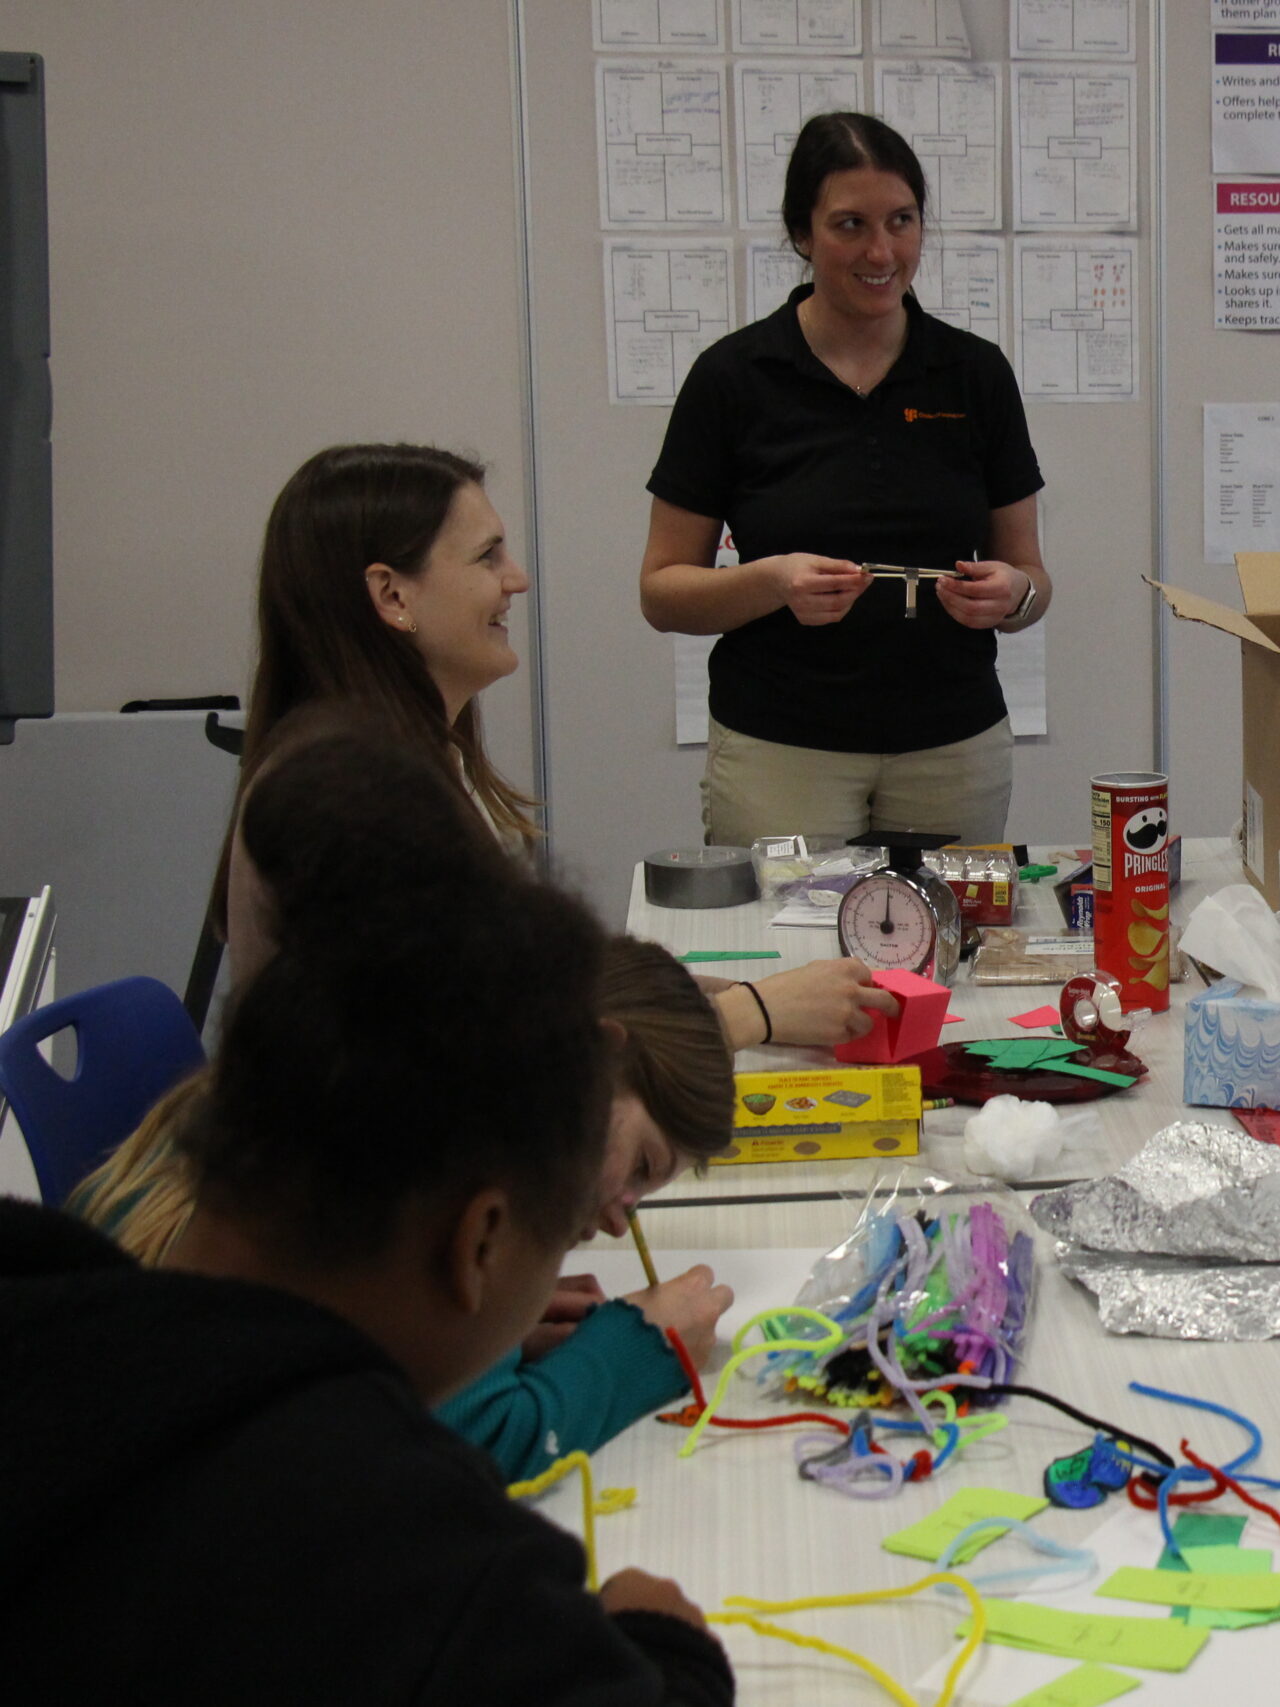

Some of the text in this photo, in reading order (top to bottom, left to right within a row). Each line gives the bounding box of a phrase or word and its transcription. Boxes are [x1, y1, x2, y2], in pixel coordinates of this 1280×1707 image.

[1222, 75, 1256, 86] Writes
[1258, 76, 1280, 86] and
[1222, 96, 1255, 107] Offers
[1223, 109, 1275, 123] complete
[1224, 224, 1249, 235] Gets
[1250, 224, 1264, 235] all
[1224, 240, 1259, 250] Makes
[1224, 252, 1280, 266] and safely.
[1225, 268, 1259, 279] Makes
[1225, 285, 1256, 295] Looks
[1225, 297, 1272, 308] shares it.
[1225, 314, 1257, 327] Keeps
[1116, 795, 1149, 803] BURSTING
[1100, 819, 1110, 827] 150
[1135, 884, 1166, 893] ORIGINAL
